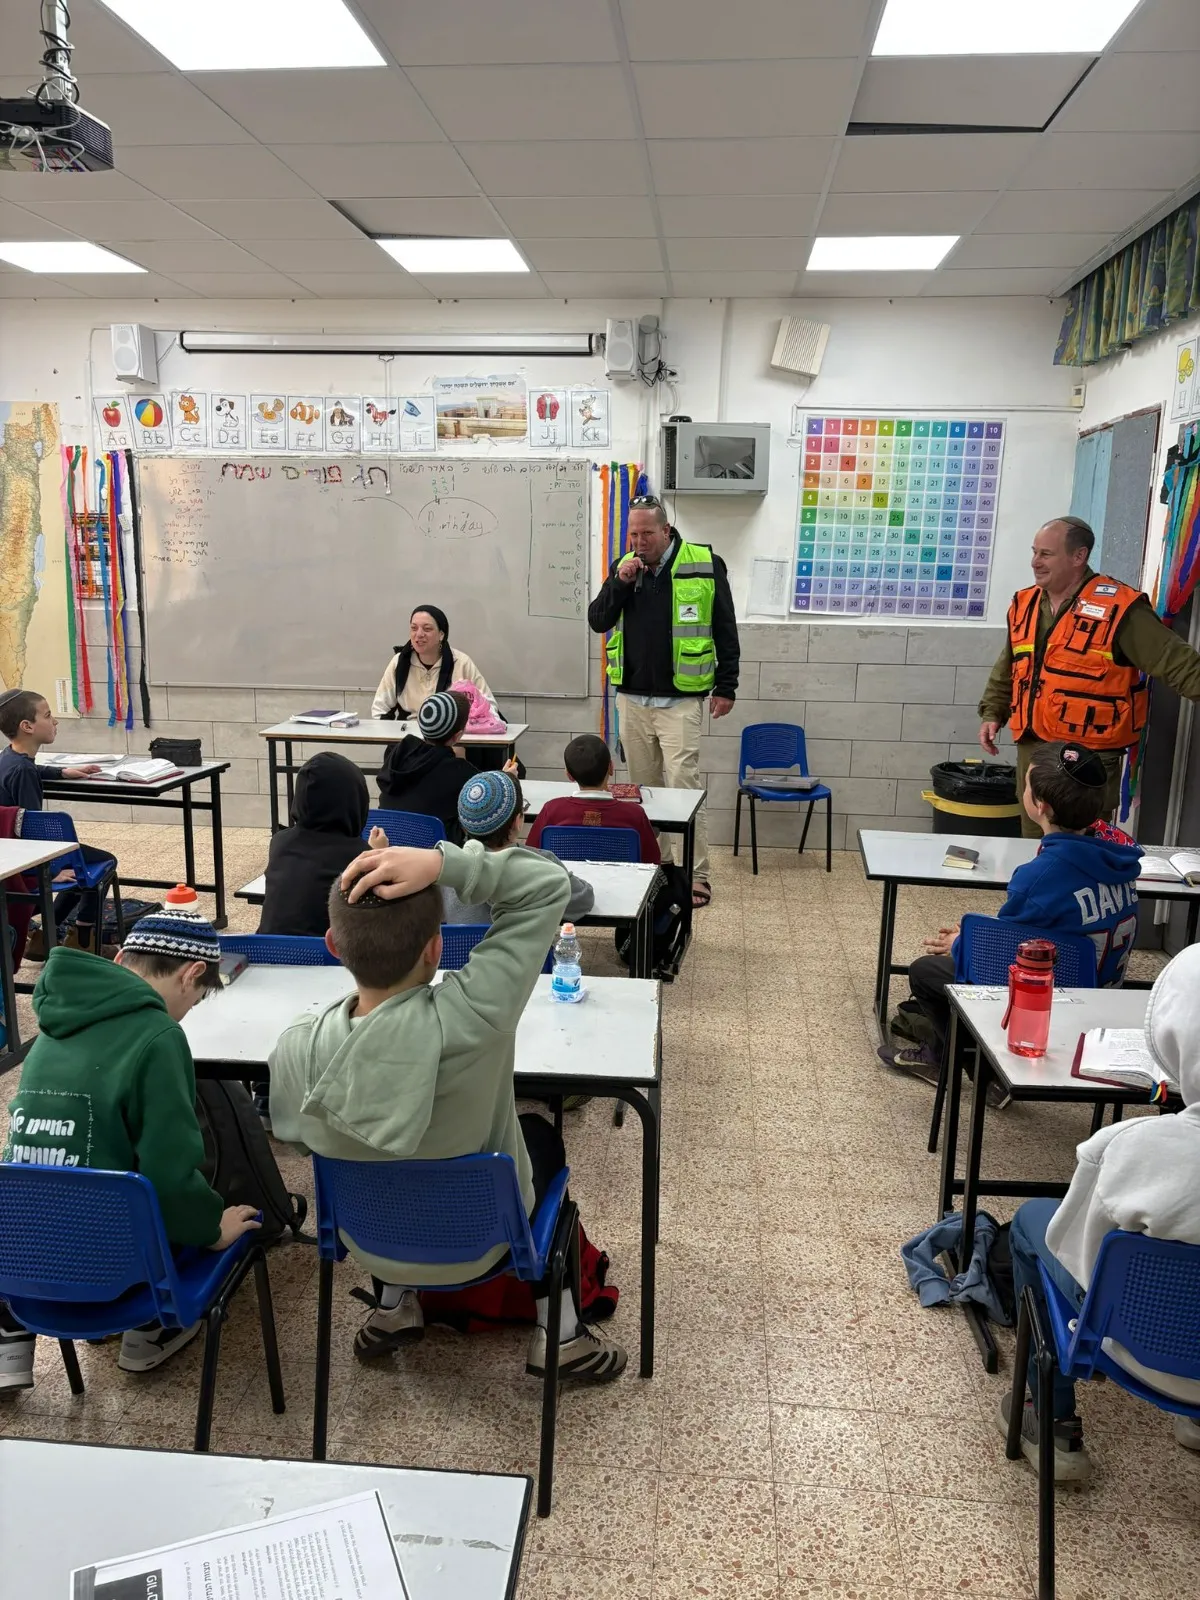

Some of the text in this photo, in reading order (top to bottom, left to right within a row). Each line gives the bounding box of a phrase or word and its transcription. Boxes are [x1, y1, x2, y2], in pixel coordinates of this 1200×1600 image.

[180, 427, 201, 443] Cc
[217, 429, 240, 444] Dd
[259, 430, 280, 444] Ee
[540, 426, 557, 445] Jj
[581, 426, 600, 442] Kk
[989, 426, 998, 434] 10
[107, 431, 127, 445] Aa
[142, 430, 164, 445] Bb
[296, 432, 316, 447] Ff
[331, 431, 353, 448] Gg
[370, 431, 392, 446] Hh
[987, 444, 996, 452] 10
[220, 462, 272, 482] שמח
[896, 460, 905, 468] 10
[914, 460, 923, 468] 12
[950, 461, 959, 469] 16
[967, 462, 976, 470] 18
[985, 462, 994, 470] 20
[877, 477, 886, 485] 12
[894, 478, 903, 486] 15
[947, 479, 956, 487] 24
[965, 480, 974, 488] 27
[876, 495, 885, 503] 16
[910, 496, 919, 504] 24
[946, 497, 955, 505] 32
[964, 498, 973, 506] 36
[981, 498, 990, 506] 40
[839, 512, 848, 520] 10
[874, 513, 883, 521] 20
[909, 514, 918, 522] 30
[944, 515, 953, 523] 40
[961, 516, 970, 524] 45
[979, 516, 988, 524] 50
[855, 530, 864, 538] 18
[890, 531, 899, 539] 30
[925, 532, 934, 540] 42
[943, 533, 952, 541] 48
[960, 533, 969, 541] 54
[978, 534, 987, 542] 60
[836, 547, 845, 555] 14
[871, 548, 880, 556] 28
[905, 549, 914, 557] 42
[923, 550, 932, 558] 49
[941, 550, 950, 558] 56
[958, 551, 967, 559] 63
[852, 565, 861, 573] 24
[886, 566, 895, 574] 40
[922, 567, 931, 575] 56
[939, 568, 948, 576] 64
[975, 569, 984, 577] 80
[833, 582, 842, 590] 18
[850, 582, 859, 590] 27
[868, 583, 877, 591] 36
[902, 584, 911, 592] 54
[919, 585, 928, 593] 63
[937, 585, 946, 593] 72
[954, 586, 963, 594] 81
[972, 586, 981, 594] 90
[797, 598, 807, 606] 10
[832, 599, 841, 607] 20
[866, 600, 875, 608] 40
[901, 601, 910, 609] 60
[919, 602, 928, 610] 70
[953, 603, 962, 611] 90
[970, 604, 982, 612] 100
[25, 1118, 75, 1136] החיים
